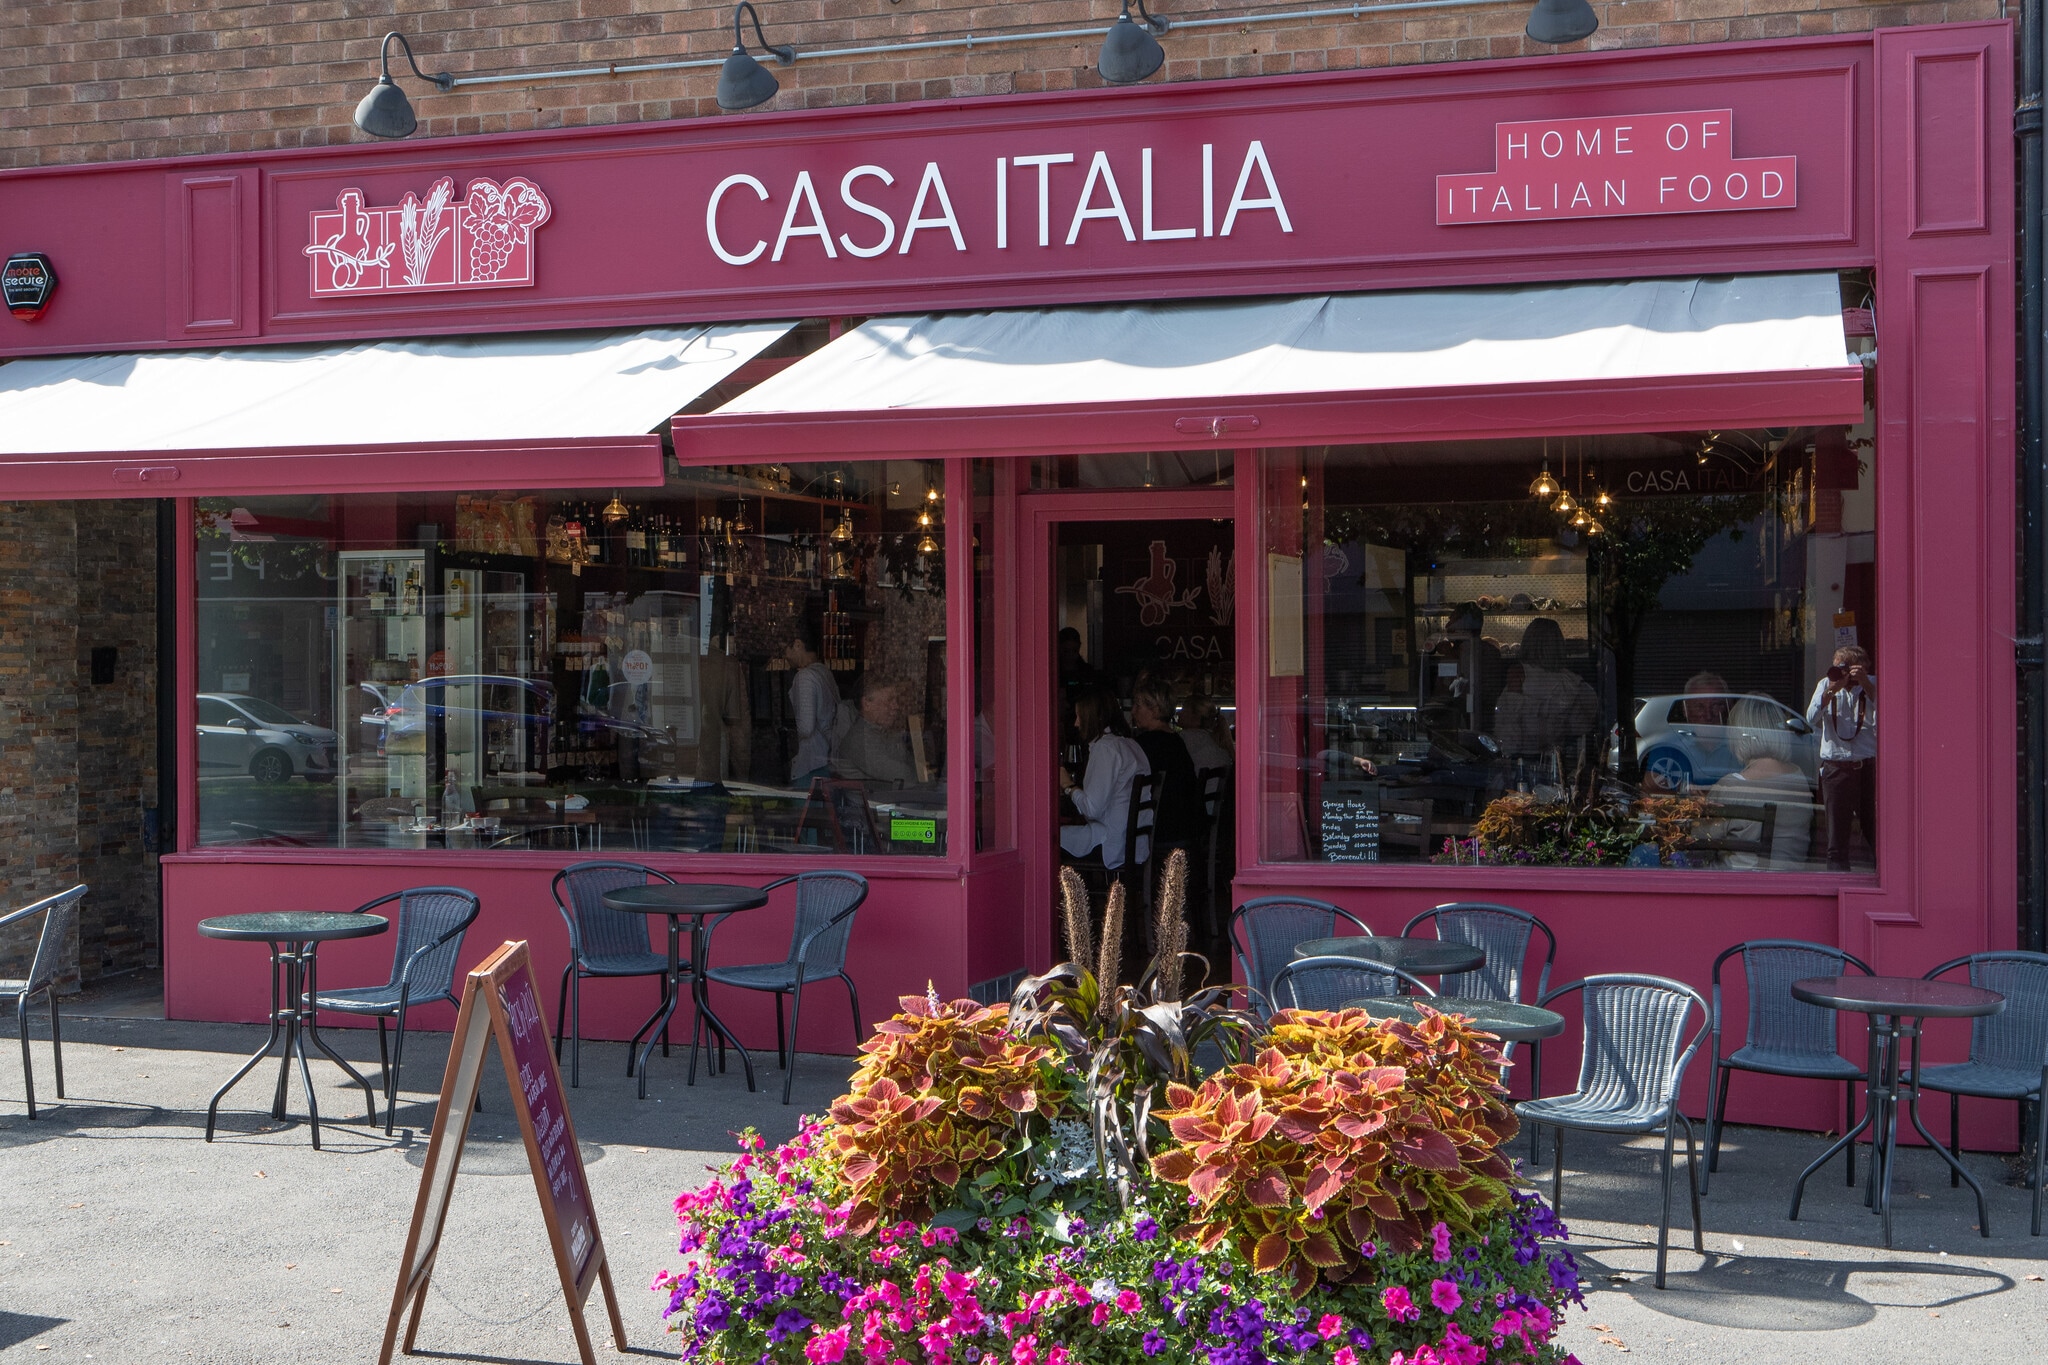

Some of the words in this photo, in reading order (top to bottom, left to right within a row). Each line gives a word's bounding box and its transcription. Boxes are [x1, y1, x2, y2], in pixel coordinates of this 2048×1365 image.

[1508, 126, 1633, 160] HOME
[1665, 121, 1721, 151] OF
[1448, 179, 1625, 215] ITALIAN
[1660, 171, 1783, 203] FOOD
[706, 161, 967, 265] CASA
[996, 140, 1293, 248] ITALIA
[5, 276, 44, 286] secure
[8, 268, 40, 277] moore
[1626, 469, 1691, 493] CASA
[1155, 635, 1223, 660] CASA
[1321, 823, 1341, 831] Friday
[1322, 832, 1350, 842] Saturday
[1323, 841, 1347, 852] Sunday
